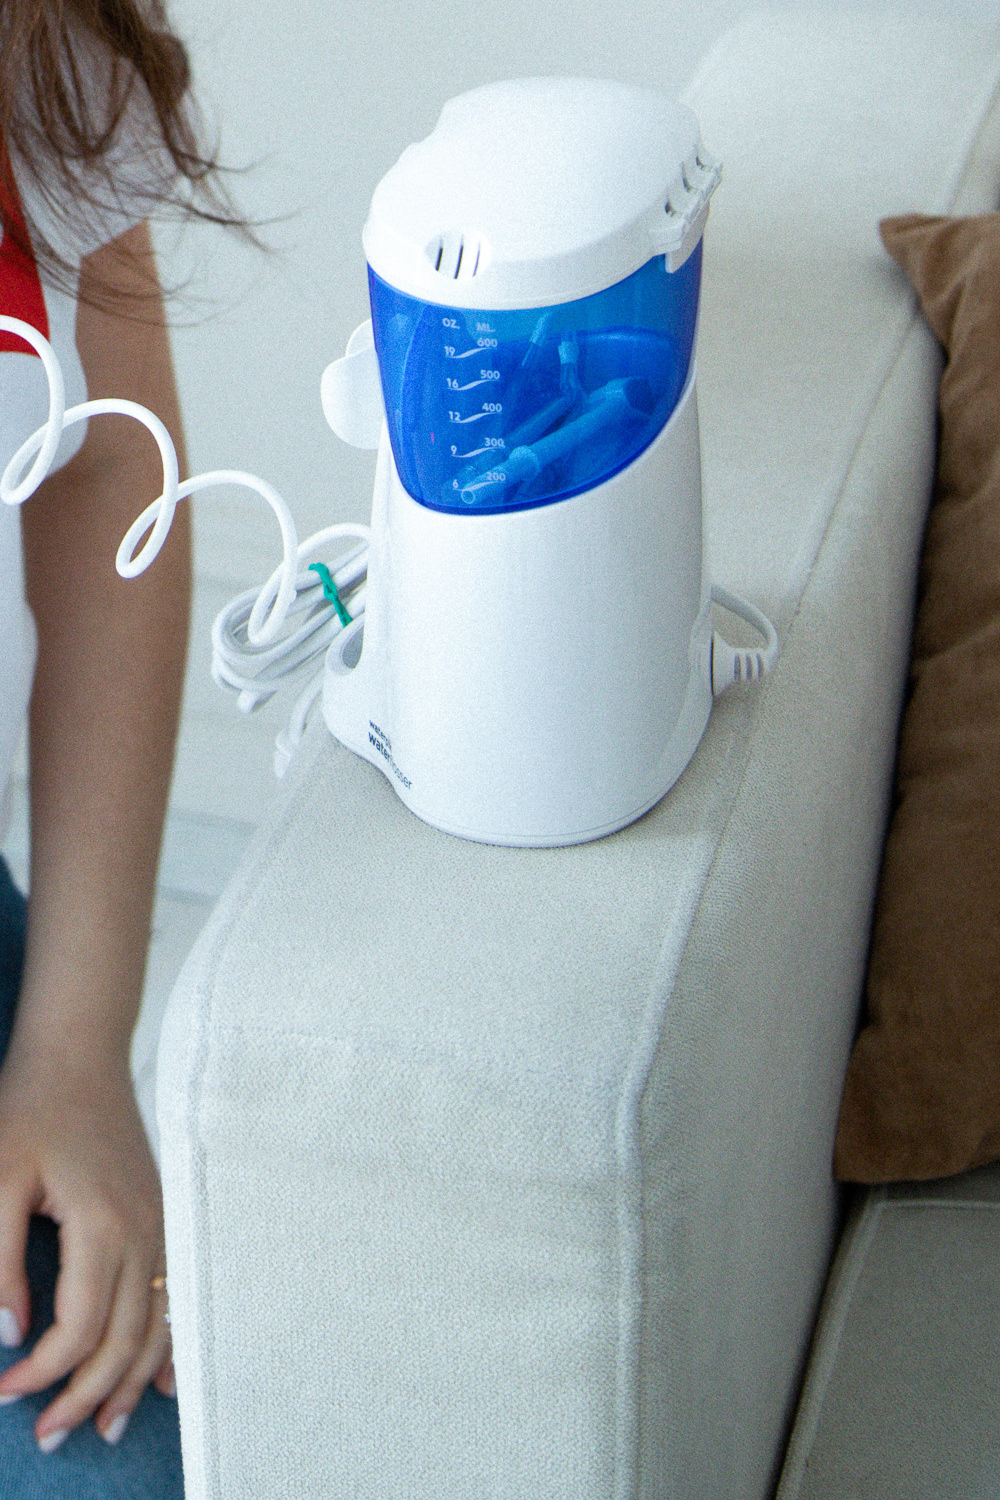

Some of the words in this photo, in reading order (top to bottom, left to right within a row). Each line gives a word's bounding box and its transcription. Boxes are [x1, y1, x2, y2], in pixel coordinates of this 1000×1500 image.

[442, 317, 460, 329] OZ.
[444, 346, 456, 357] 19
[477, 337, 498, 348] 600
[447, 377, 459, 389] 16
[480, 369, 500, 380] 500
[449, 411, 461, 422] 12
[482, 402, 502, 413] 400
[451, 445, 458, 456] 9
[484, 437, 504, 448] 300
[452, 479, 459, 489] 6
[486, 471, 506, 482] 200
